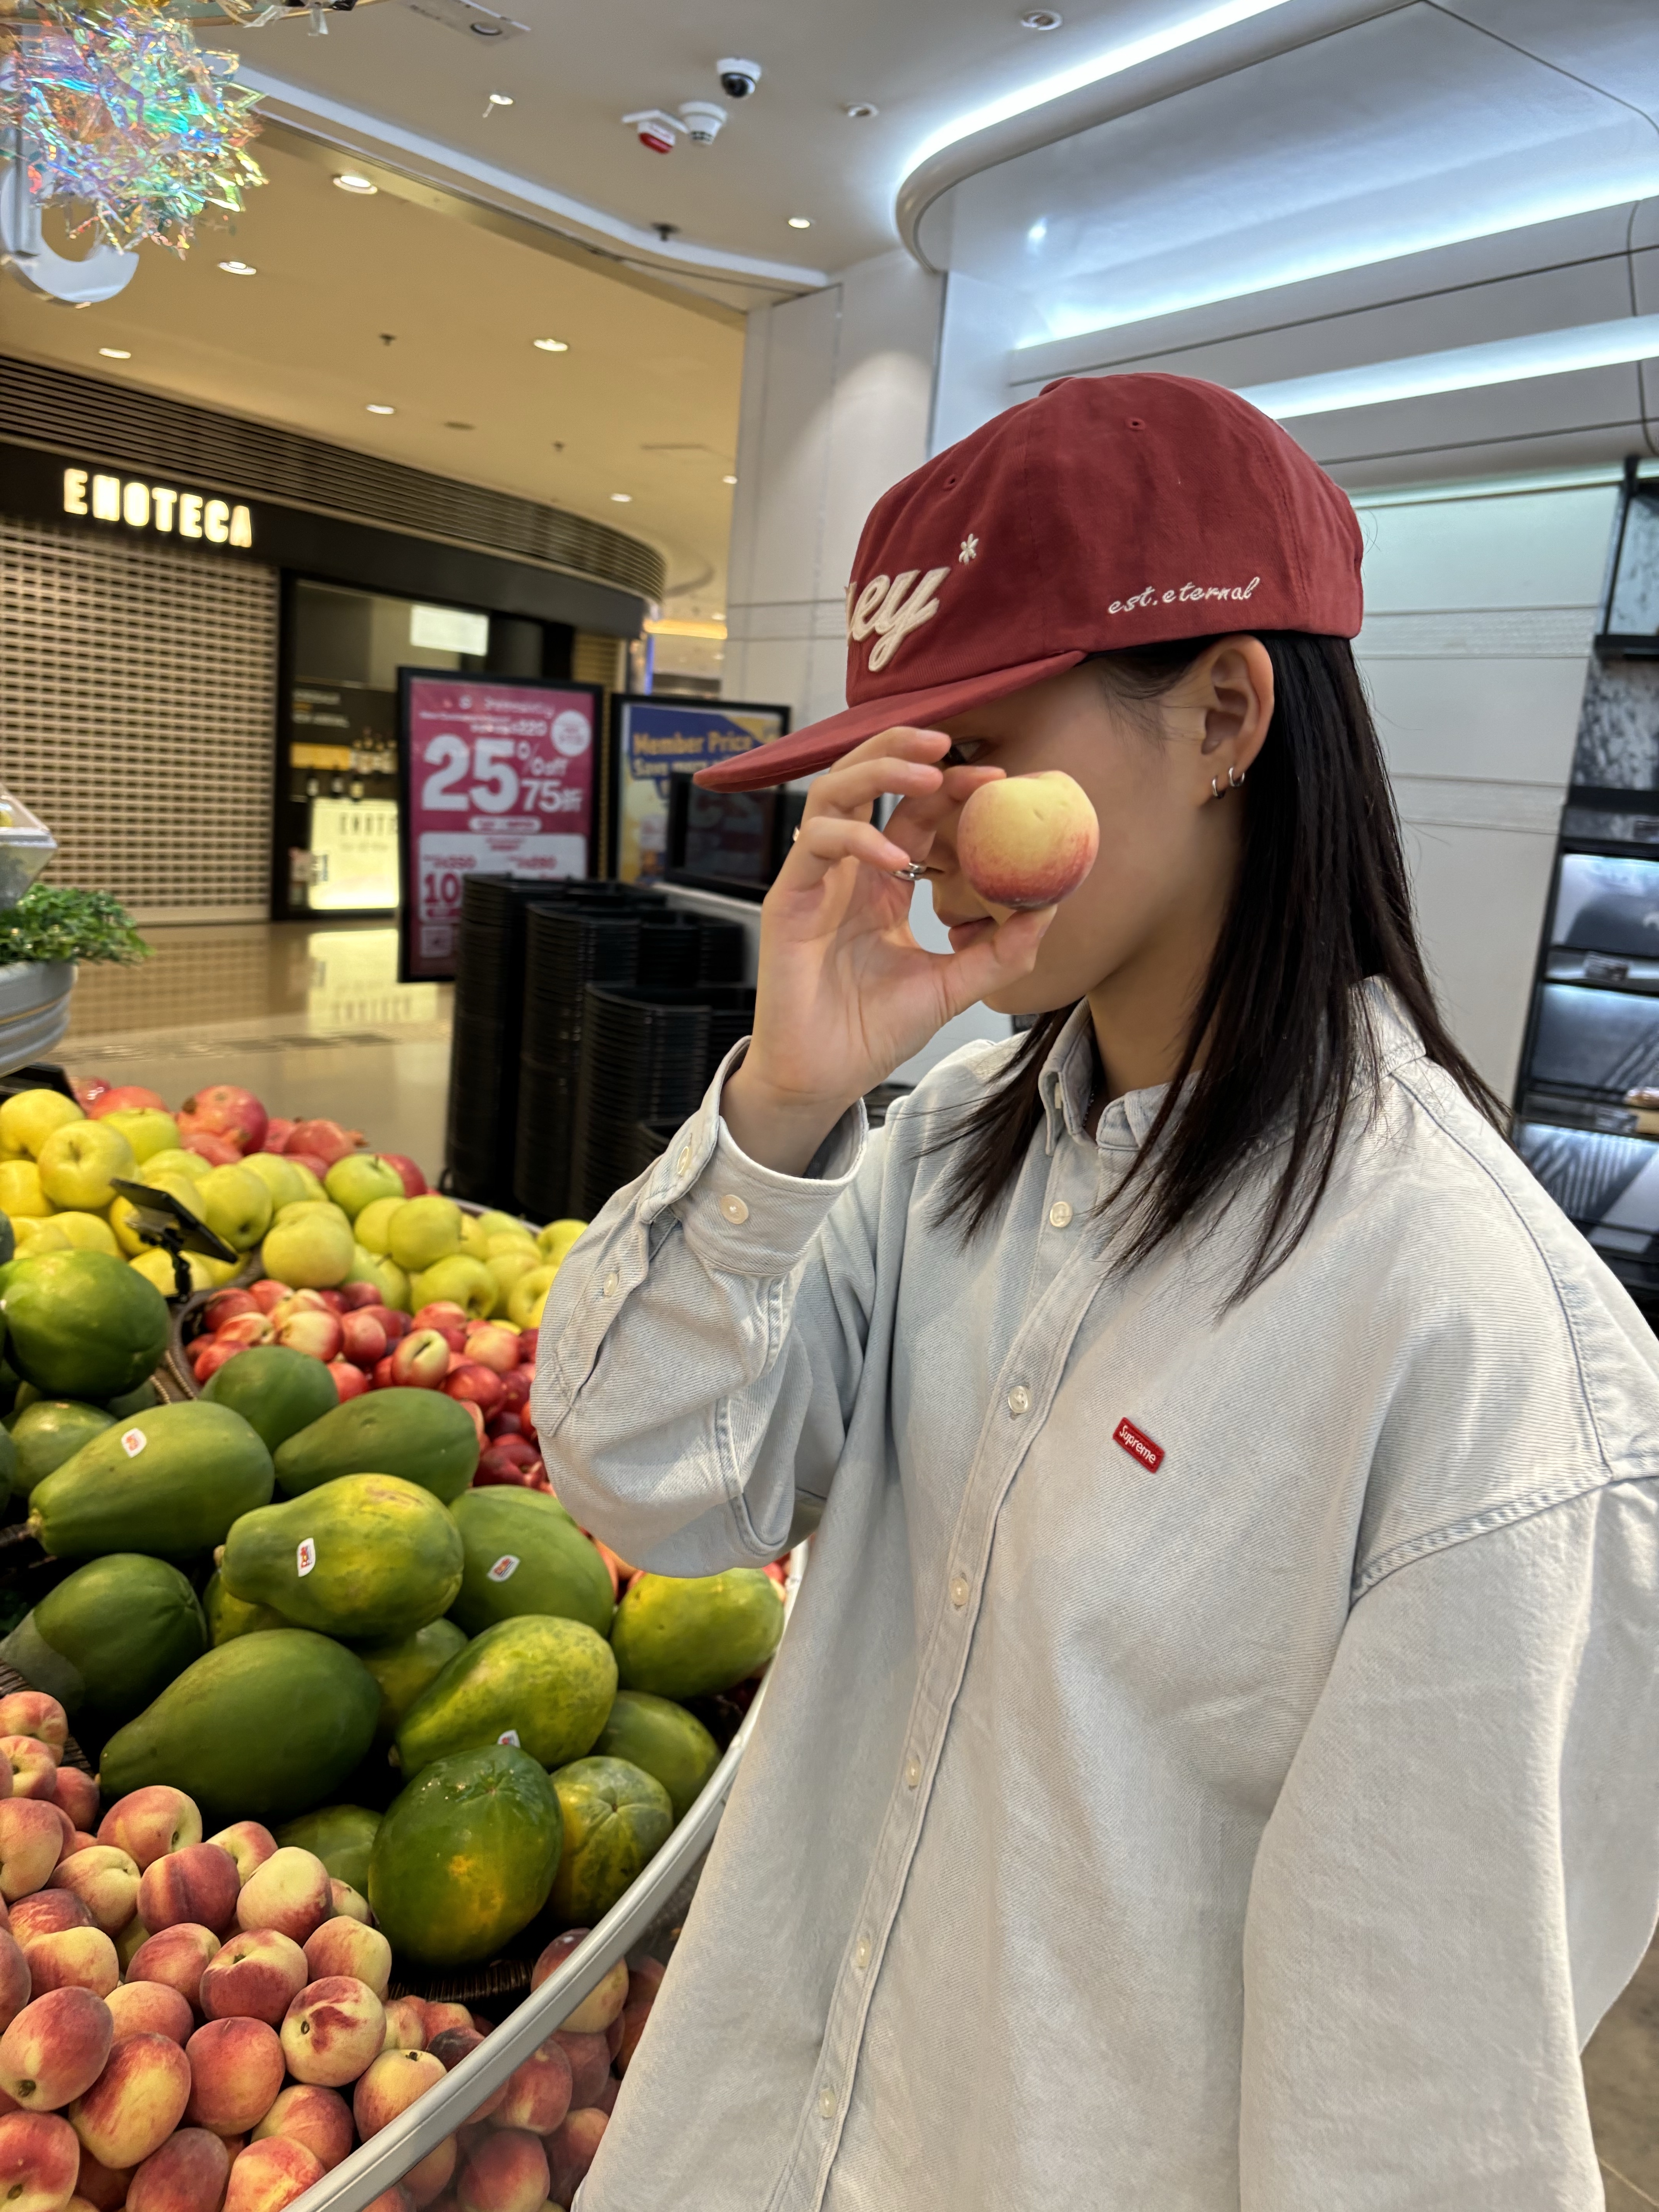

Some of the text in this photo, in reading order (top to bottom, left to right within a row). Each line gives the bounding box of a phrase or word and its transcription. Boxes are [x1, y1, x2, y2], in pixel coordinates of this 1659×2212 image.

[64, 468, 252, 548] ENOTECA
[633, 731, 752, 755] Member Price
[1119, 1425, 1156, 1463] Supreme
